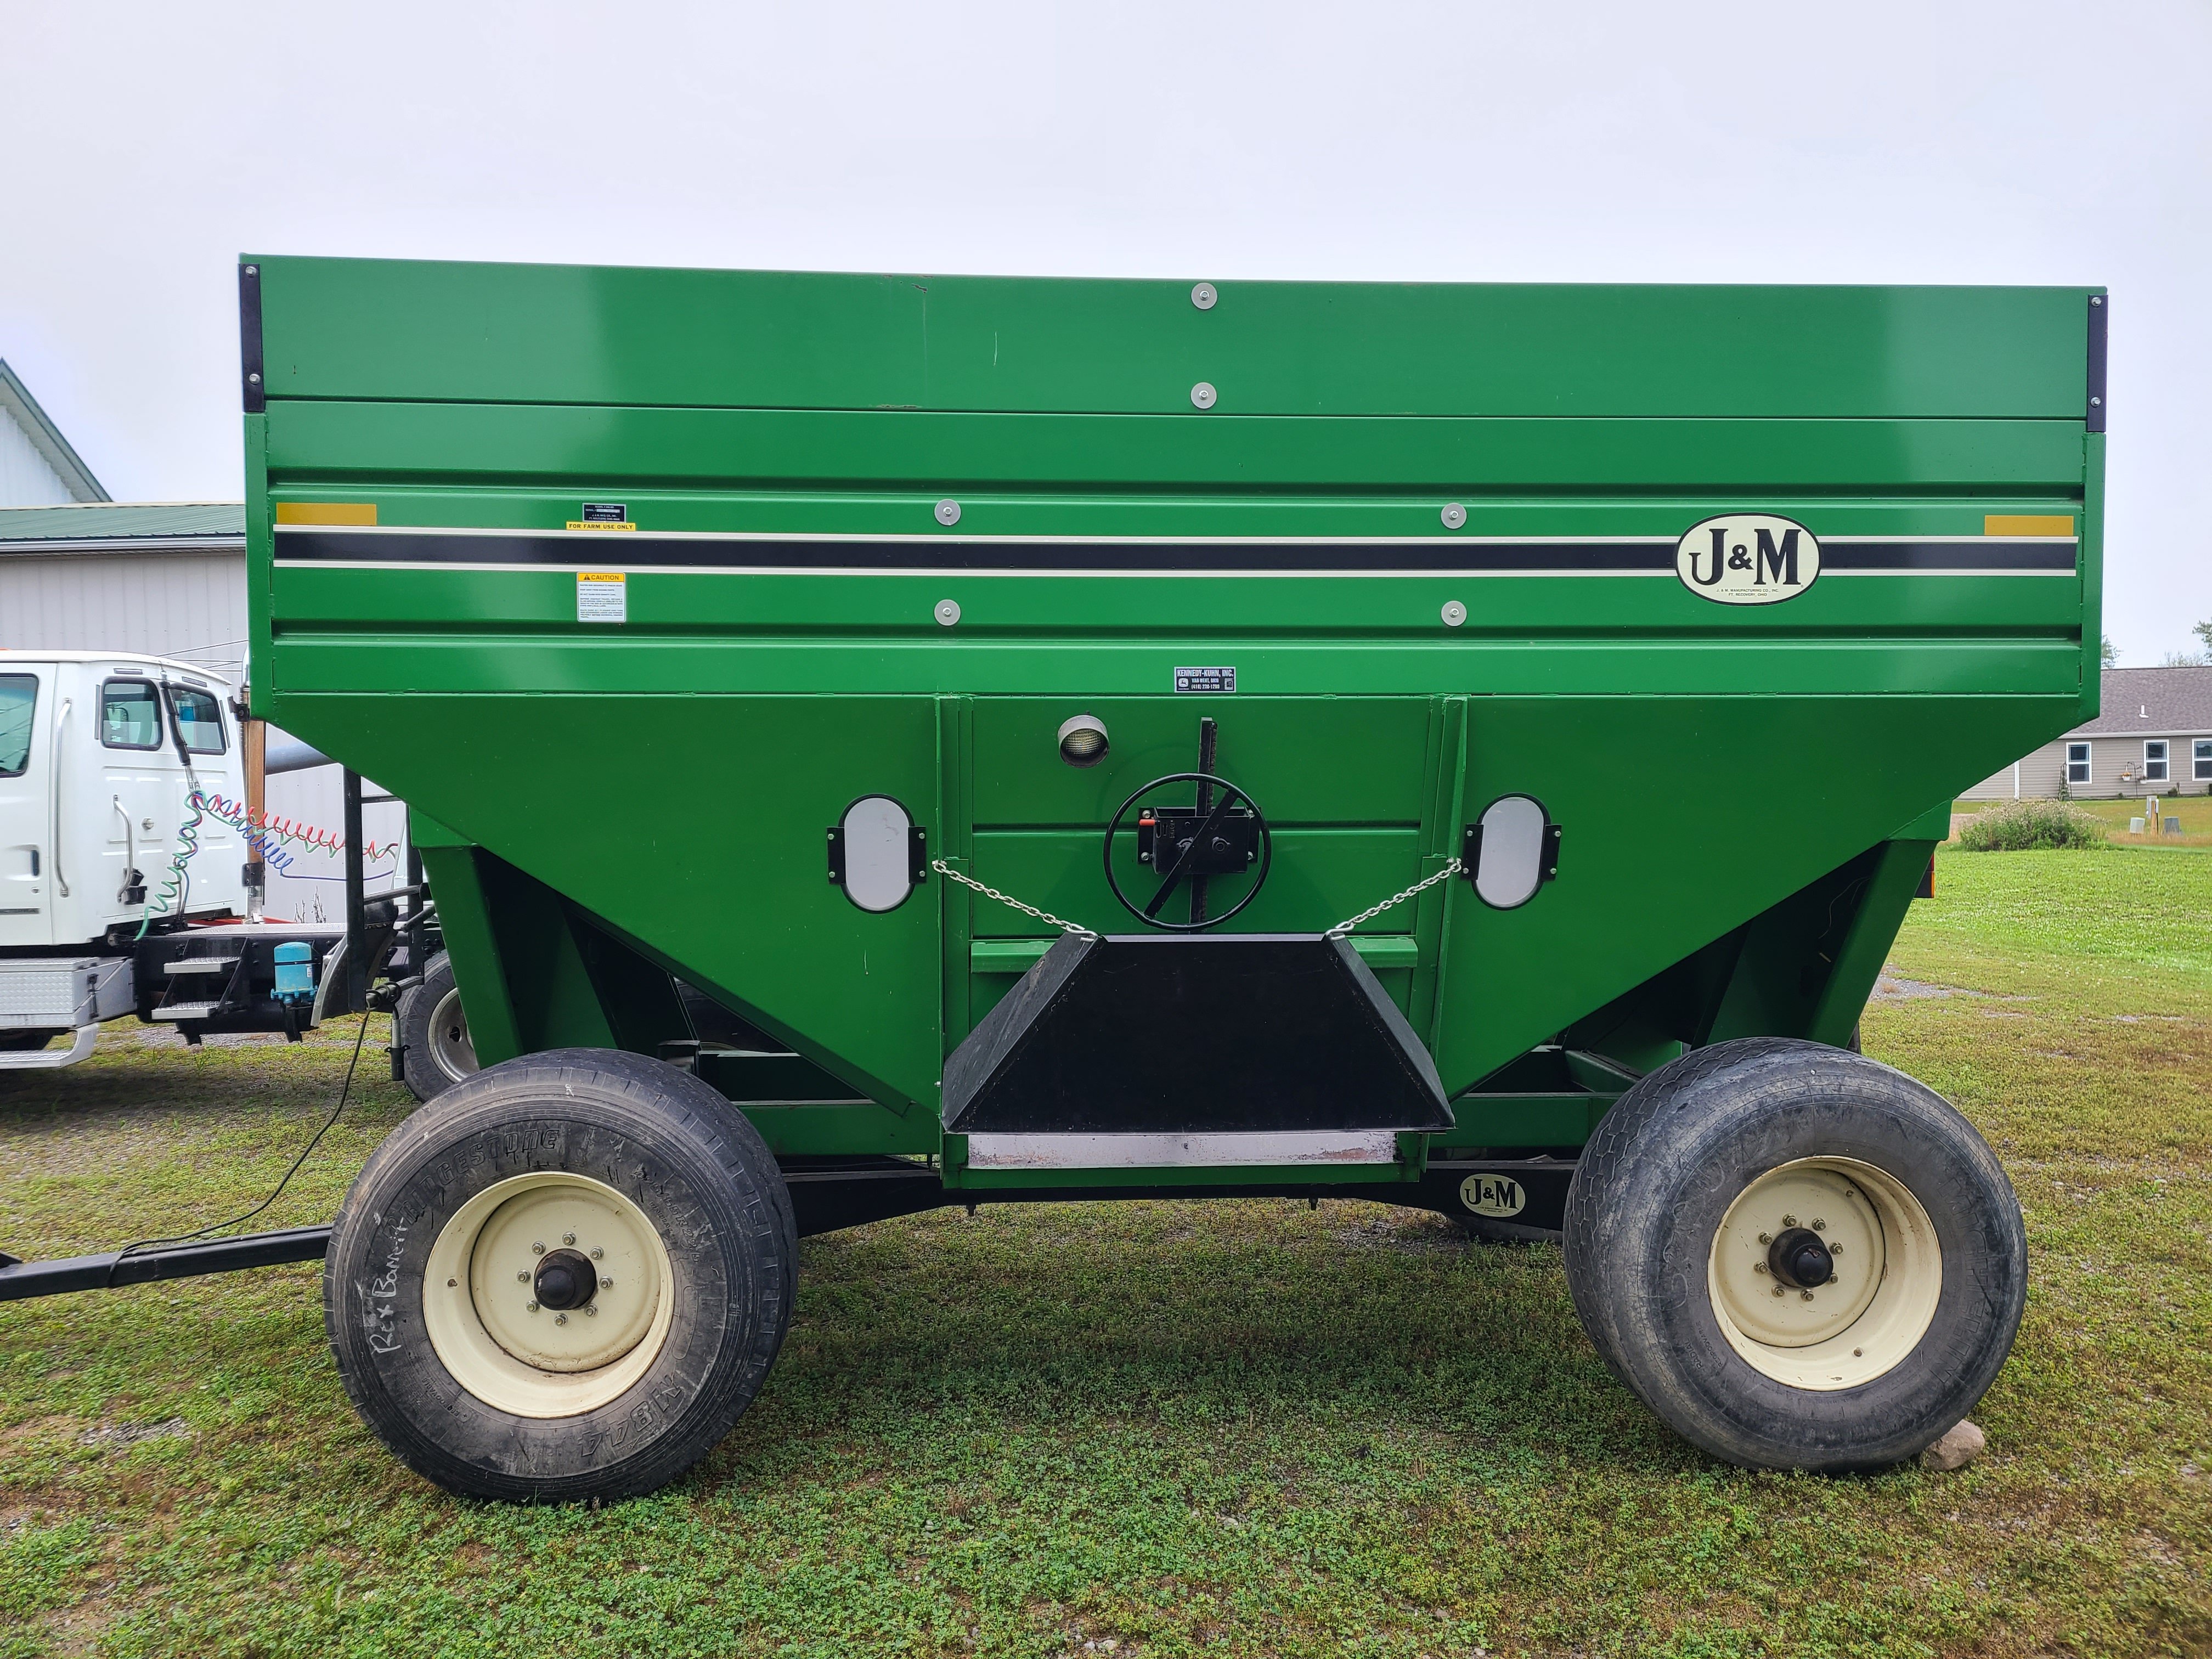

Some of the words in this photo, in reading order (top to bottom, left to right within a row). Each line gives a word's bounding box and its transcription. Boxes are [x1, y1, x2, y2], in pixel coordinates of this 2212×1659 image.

[1689, 528, 1802, 586] J&M
[1177, 669, 1221, 678] KENNEDY-KUHN,
[382, 1128, 560, 1241] BRIDGESTONE
[1464, 1178, 1518, 1209] J&M
[1928, 1177, 1989, 1384] MICHELIN
[369, 1304, 402, 1355] Rex
[1684, 1338, 1703, 1369] RADIAL
